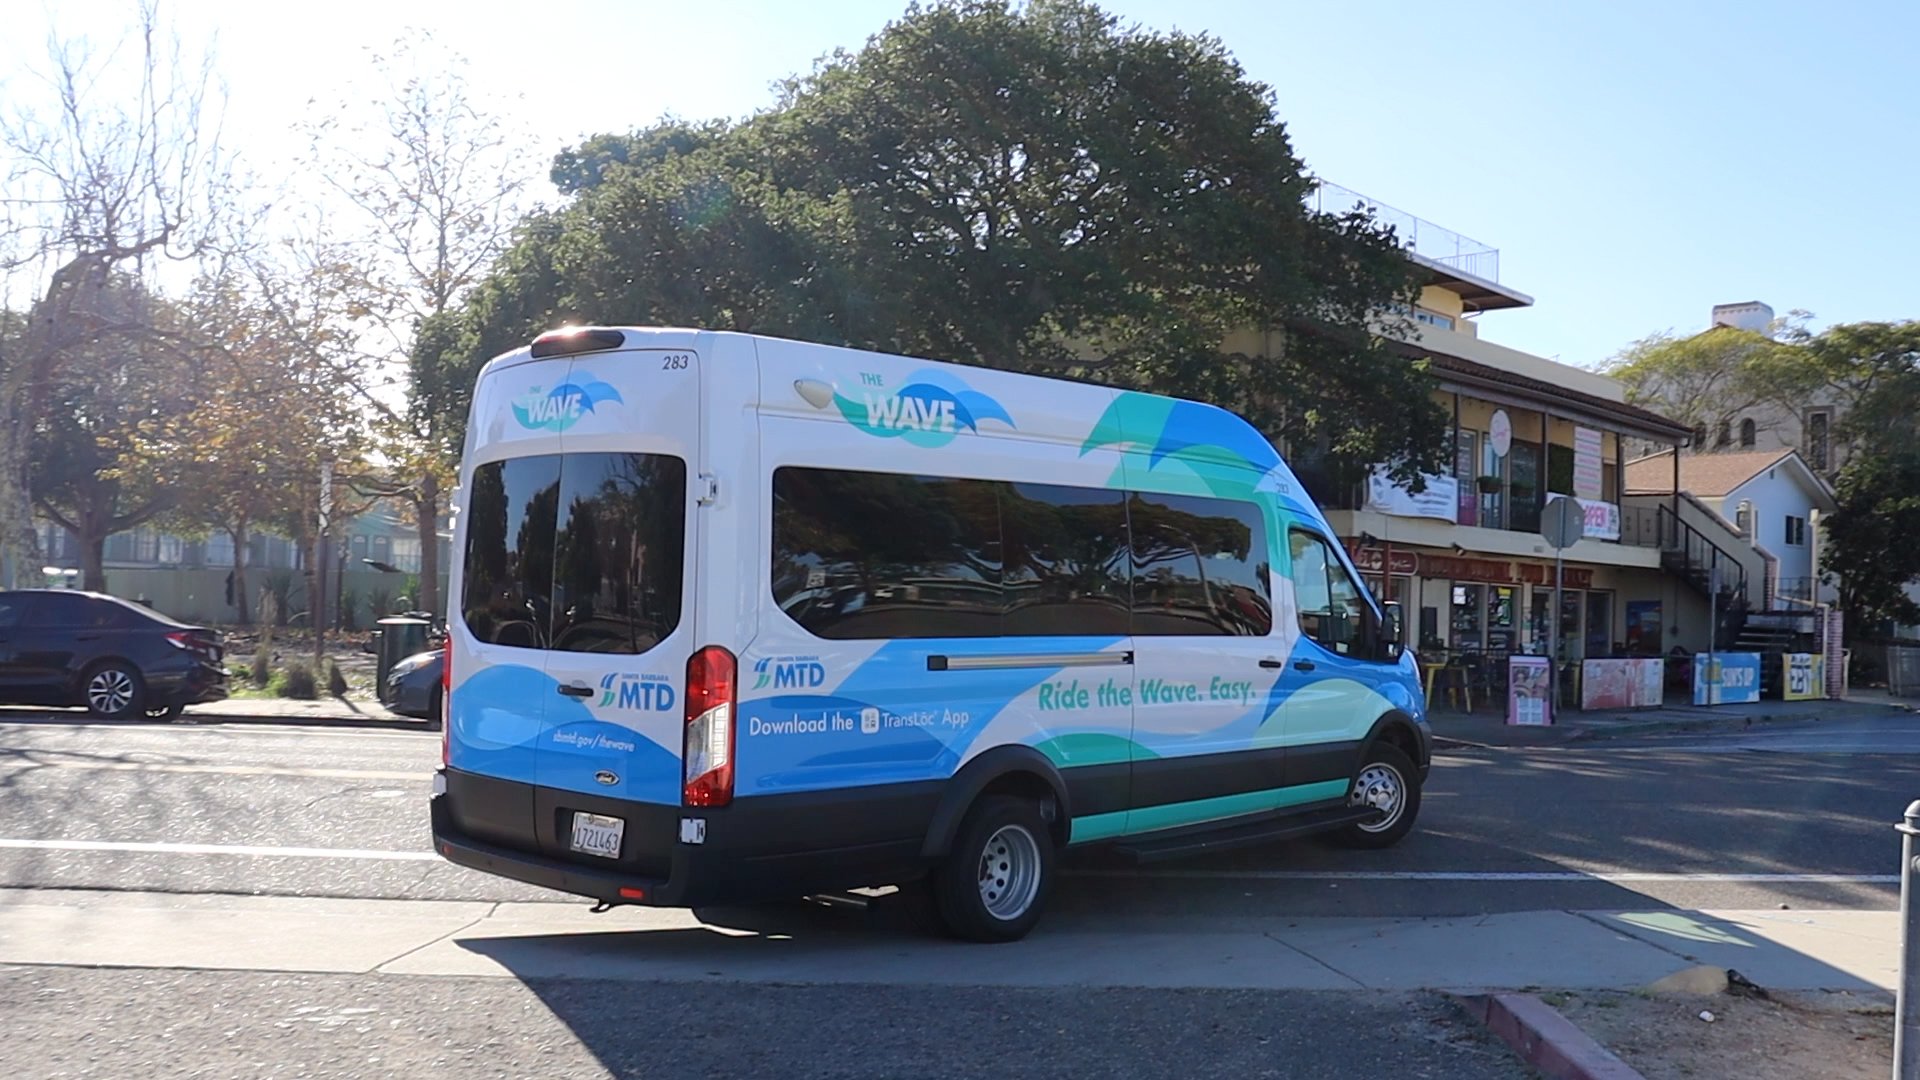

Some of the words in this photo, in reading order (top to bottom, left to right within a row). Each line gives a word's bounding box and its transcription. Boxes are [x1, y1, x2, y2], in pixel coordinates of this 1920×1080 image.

[662, 355, 688, 370] 283
[860, 373, 883, 386] THE
[527, 393, 582, 423] WAVE
[865, 393, 955, 431] WAVE
[773, 663, 825, 689] MTD
[618, 682, 674, 711] MTD
[1039, 680, 1089, 711] Ride
[1097, 678, 1131, 707] the
[1140, 679, 1202, 704] Wave.
[1210, 676, 1256, 706] Easy.
[750, 712, 827, 736] Download
[831, 711, 854, 731] the
[942, 708, 969, 728] App
[575, 827, 619, 851] 1721463
